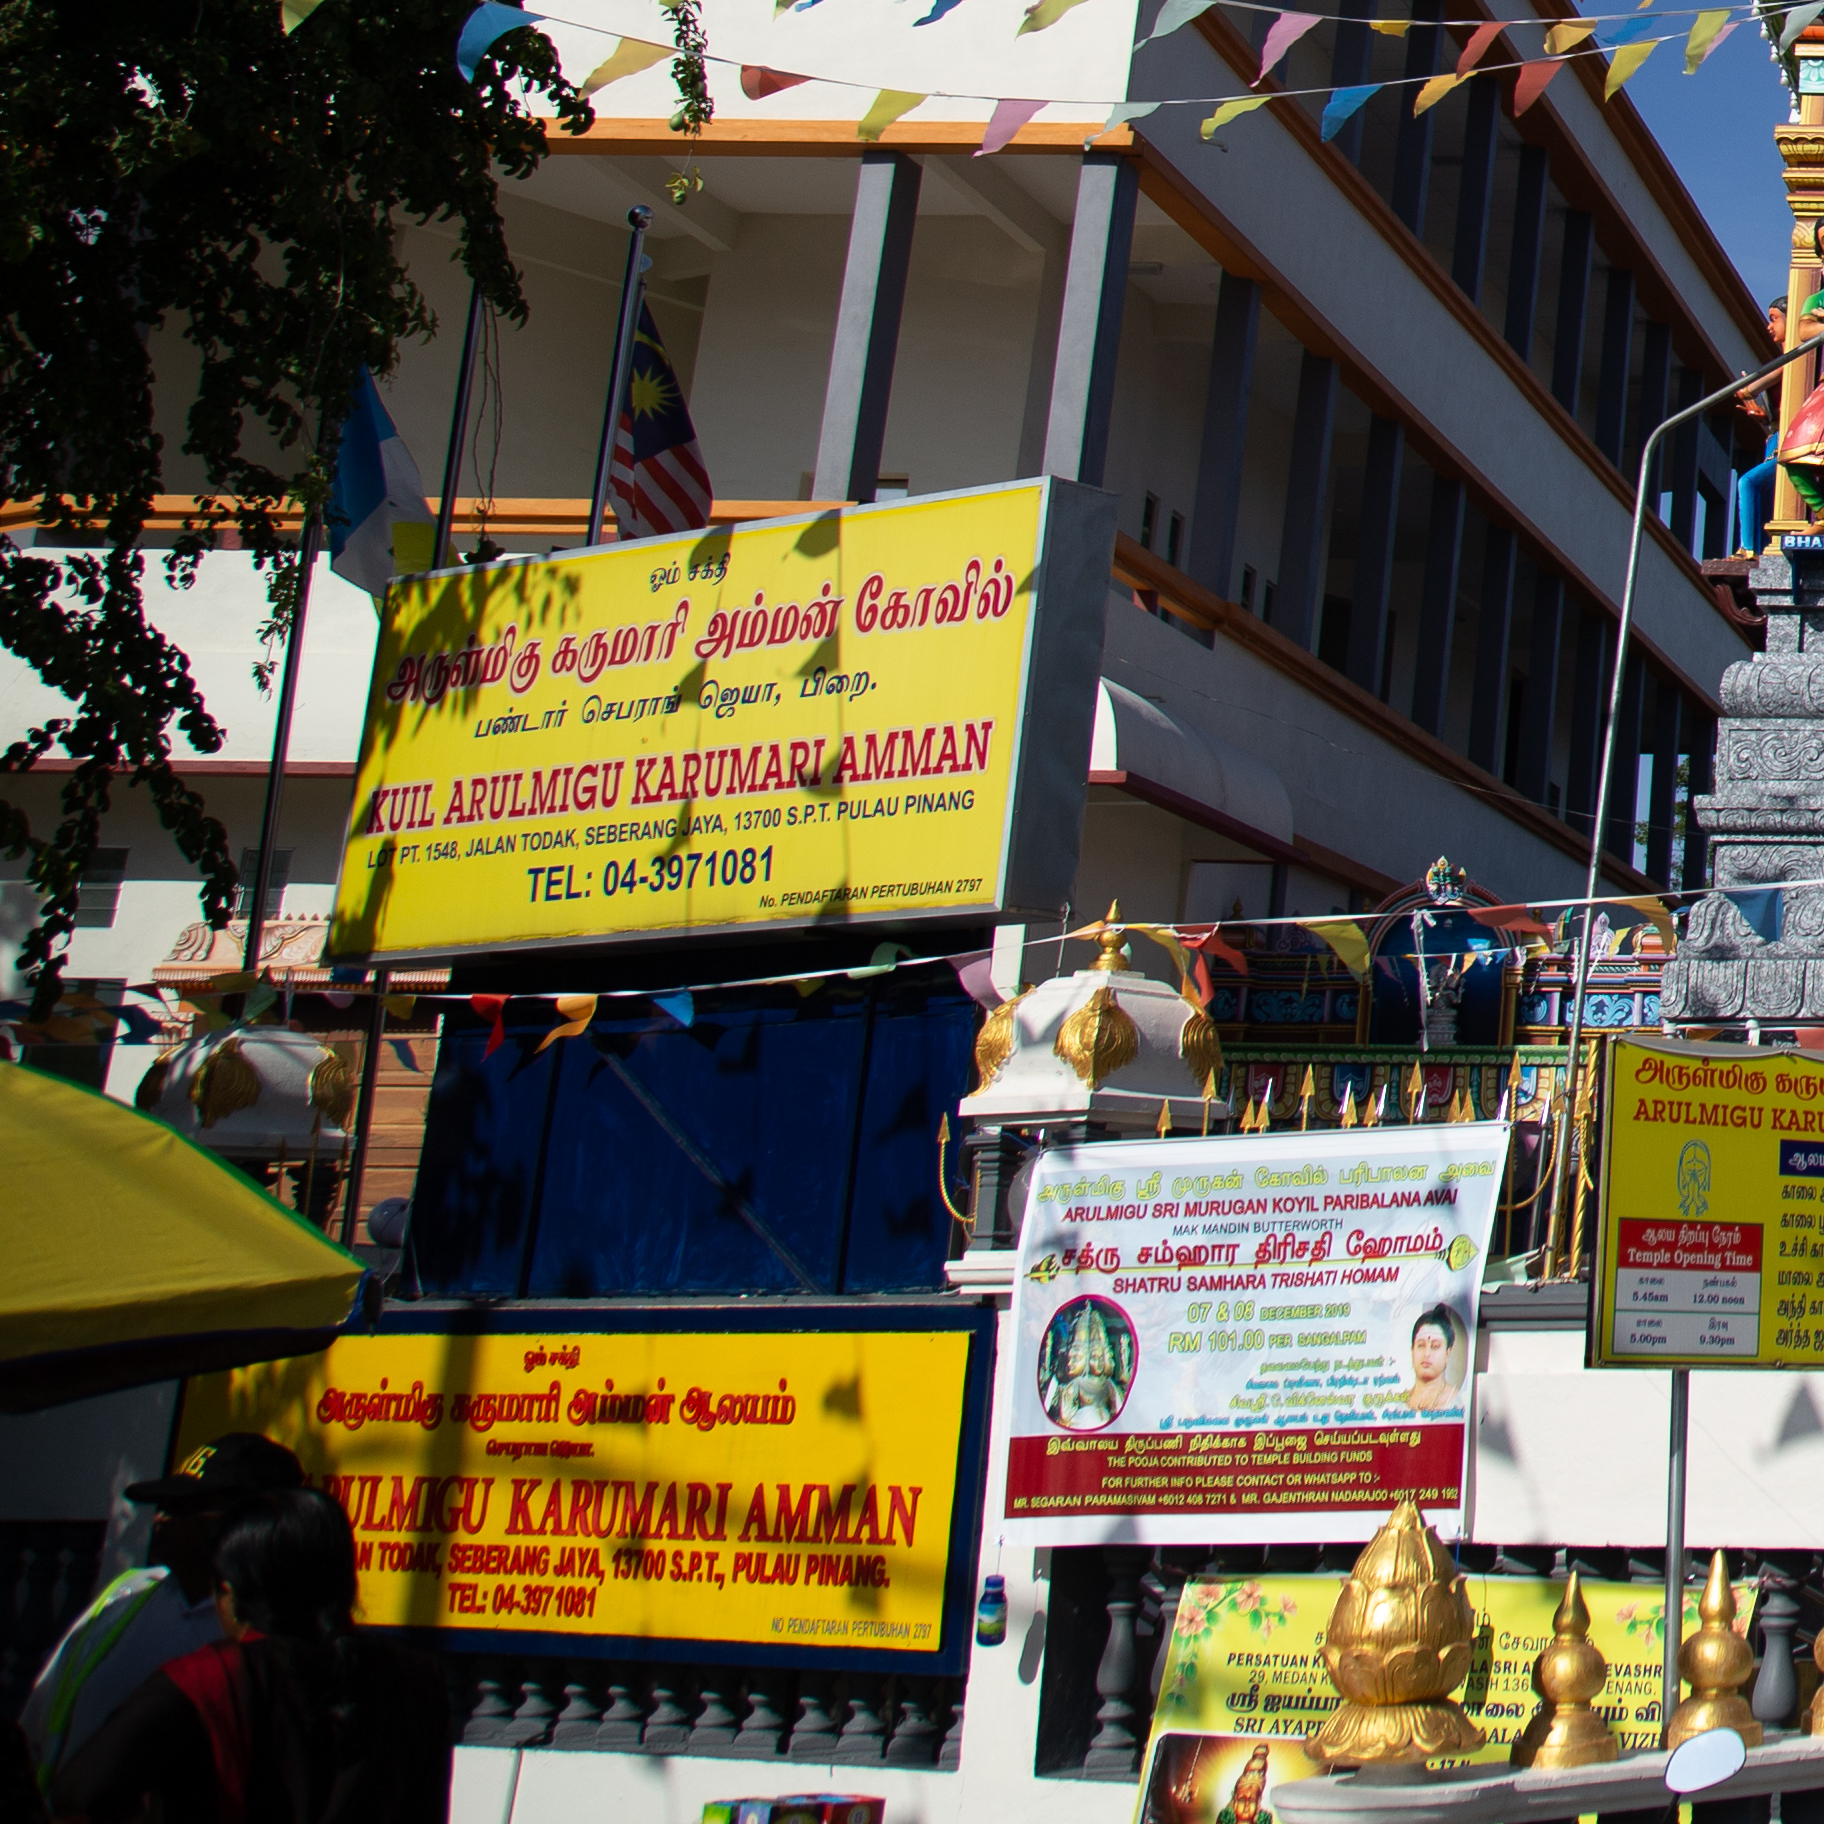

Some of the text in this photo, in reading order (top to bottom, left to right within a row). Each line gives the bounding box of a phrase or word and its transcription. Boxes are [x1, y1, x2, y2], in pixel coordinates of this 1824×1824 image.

[651, 551, 731, 592] ஓம் சக்தி
[387, 559, 1014, 703] அருள்மிகு கருமாரி அம்மன் கோவில்
[475, 700, 568, 737] பண்டார்
[583, 683, 682, 723] செபராங்
[367, 722, 993, 833] KUIL ARULMIGU KARUMARI AMMAN
[368, 790, 974, 869] LOT PT. 1548, JALAN TODAK, SEBERANG JAYA, 13700 S.P.T. PULAU PINANG
[528, 846, 772, 902] TEL: 04-3971081
[760, 878, 983, 907] No. PENDAFTARAN PERTUBUHAN 2797
[1635, 1053, 1767, 1094] அருள்மிகு
[1633, 1099, 1763, 1128] ARULMIGU
[1037, 1174, 1125, 1205] அருள்மிகு
[1172, 1169, 1244, 1198] முருகன்
[1255, 1164, 1328, 1188] கோவில்
[1340, 1161, 1429, 1187] பரிபாலன
[1782, 1185, 1816, 1200] காலை
[1063, 1189, 1458, 1222] ARULMIGU SRI MURUGAN KOYIL PARIBALANA AVAI
[1173, 1219, 1343, 1235] MAK MANDIN BUTTERWORTH
[1781, 1213, 1815, 1229] காலை
[1060, 1227, 1443, 1274] சத்ரு சம்ஹார திரிசதி ஹோமம்
[1628, 1248, 1752, 1268] Temple Opening Time
[1113, 1267, 1399, 1293] SHATRU SAMHARA TRISHATI HOMAM
[1188, 1300, 1350, 1323] 07 & 08 DECEMBER 2019
[1694, 1294, 1744, 1305] 12.00 noon
[1168, 1332, 1202, 1353] RM
[1208, 1329, 1265, 1352] 101.00
[1269, 1334, 1293, 1349] PER
[316, 1377, 796, 1433] அருள்மிகு கருமாரி அம்மன் ஆலயம்
[1108, 1451, 1372, 1467] THE POOJA CONTRIBUTED TO TEMPLE BUILDING FUNDS
[1102, 1472, 1371, 1488] FOR FURTHER INFO PLEASE CONTACT OR WHATSAPP TO
[505, 1479, 922, 1547] KARUMARI AMMAN
[1031, 1489, 1387, 1508] SEGARAN PARAMASIVAM NADARAJOO
[379, 1541, 441, 1579] TODAK,
[449, 1542, 550, 1576] SEBERANG
[554, 1547, 604, 1586] JAYA,
[613, 1548, 666, 1580] 13700
[670, 1550, 725, 1590] S.P.T.,
[732, 1553, 800, 1585] PULAU
[804, 1555, 889, 1589] PINANG.
[449, 1584, 596, 1617] TEL: 04-3971081
[788, 1618, 910, 1638] PENDAFTARAN PERTUBUHAN
[1226, 1652, 1312, 1668] PERSATUAN
[1493, 1662, 1518, 1675] SRI
[1249, 1670, 1657, 1697] 29, MEDAN ENANG.
[1234, 1717, 1264, 1734] SRI
